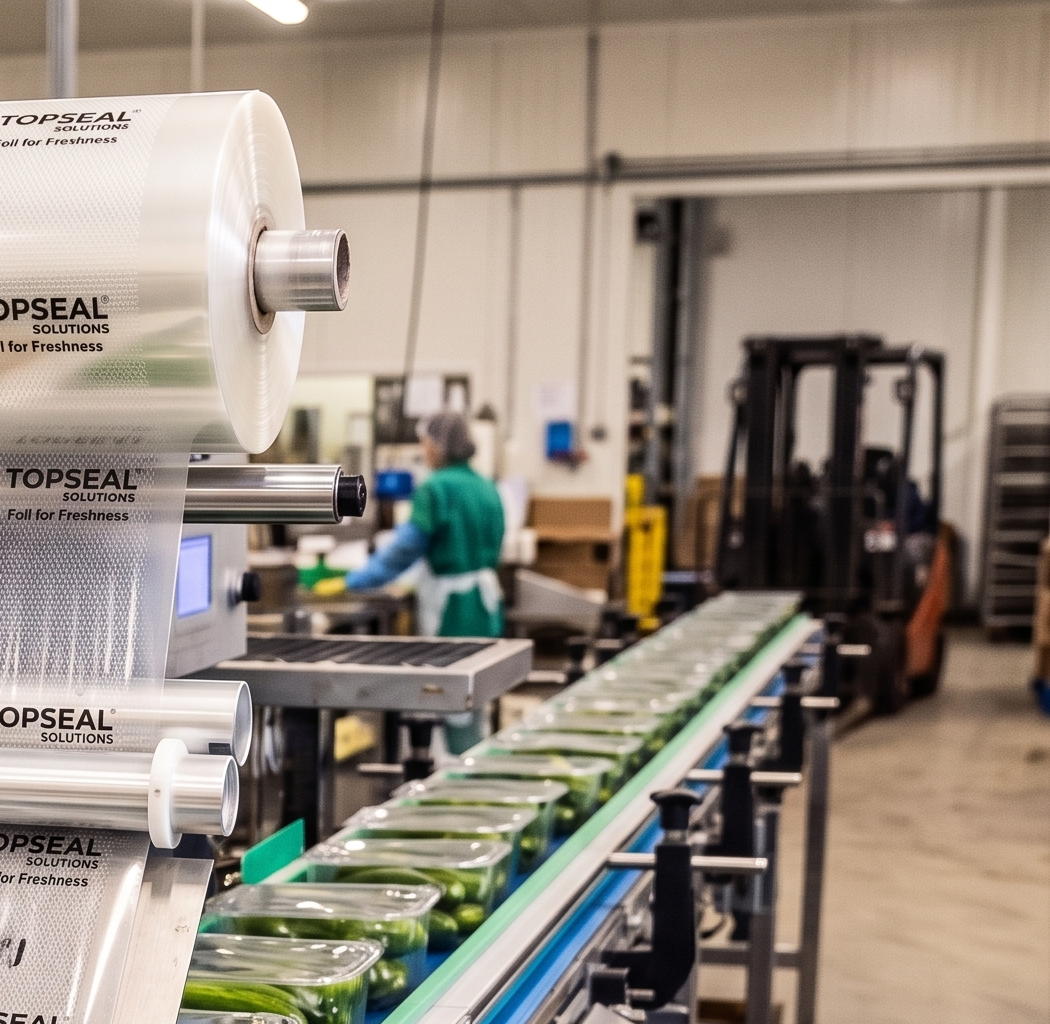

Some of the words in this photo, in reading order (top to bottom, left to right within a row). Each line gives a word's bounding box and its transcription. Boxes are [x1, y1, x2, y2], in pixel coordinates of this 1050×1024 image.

[54, 123, 129, 132] SOLUTIONS
[22, 138, 42, 147] for
[45, 135, 118, 146] Freshness
[33, 324, 110, 334] SOLUTIONS
[8, 340, 28, 352] for
[31, 340, 103, 352] Freshness
[62, 492, 135, 502] SOLUTIONS
[35, 508, 55, 521] for
[58, 509, 129, 521] Freshness
[41, 732, 114, 744] SOLUTIONS
[26, 856, 99, 869] SOLUTIONS
[18, 873, 88, 887] Freshness
